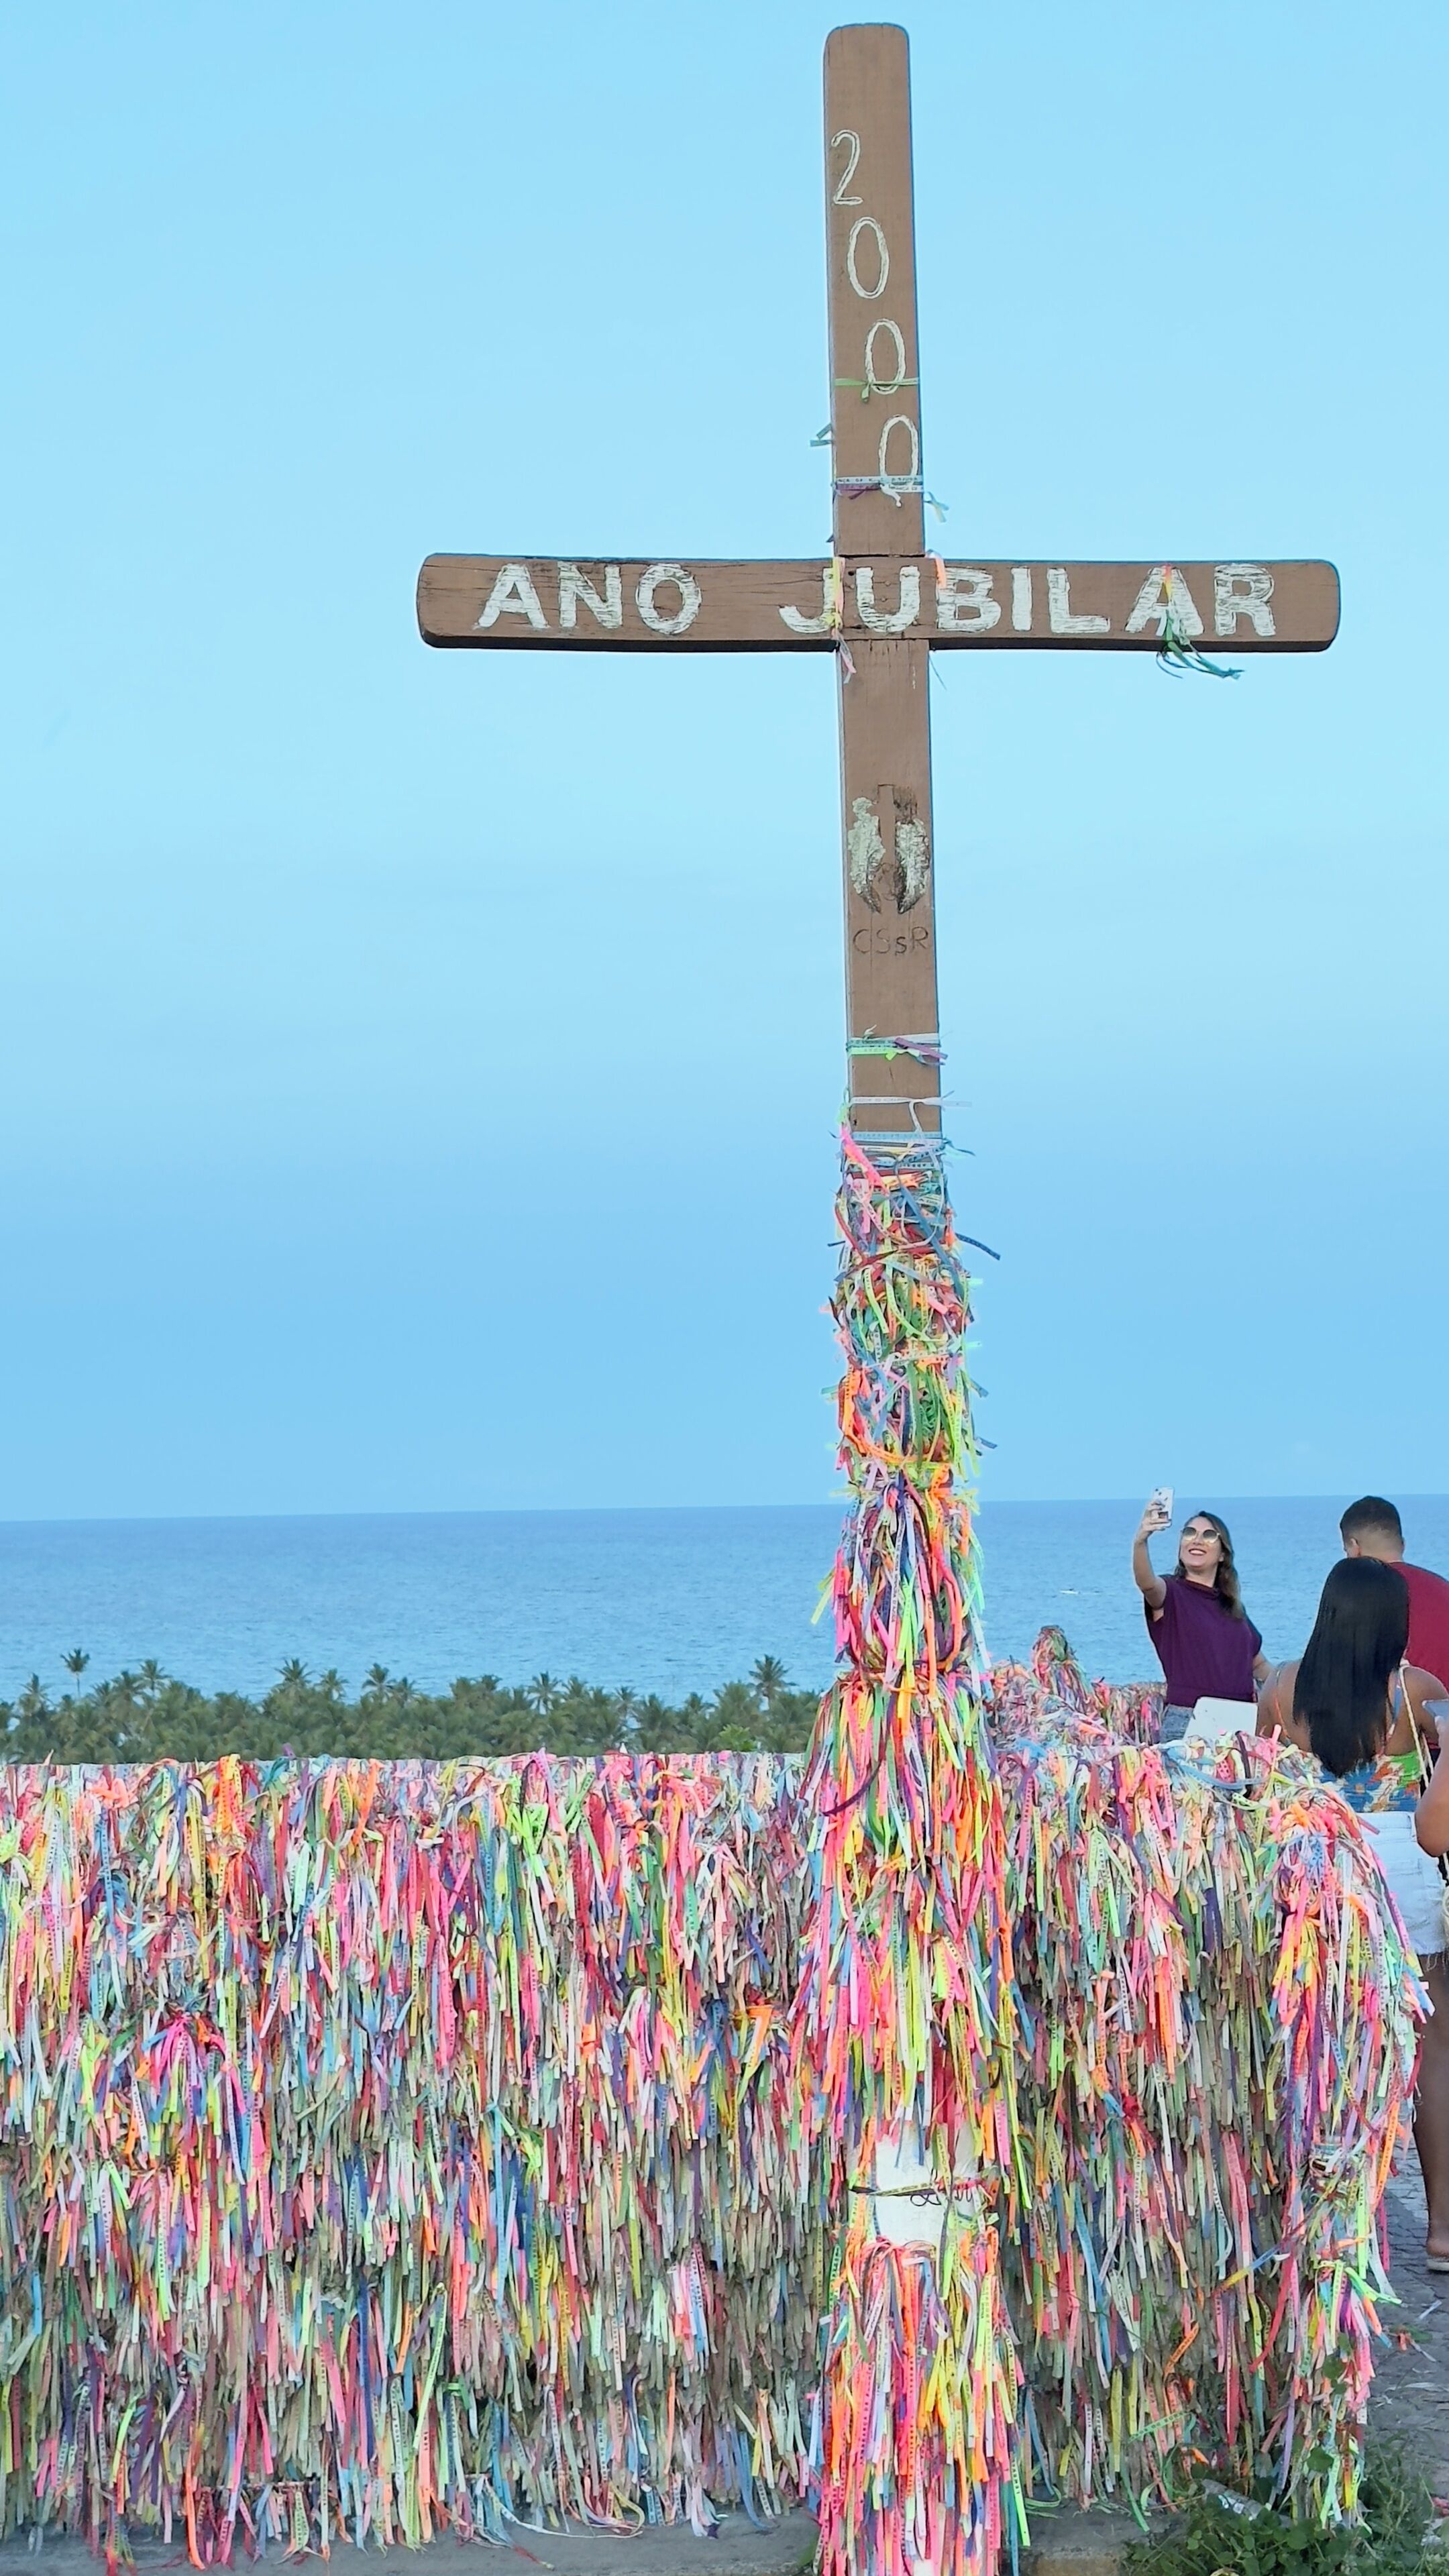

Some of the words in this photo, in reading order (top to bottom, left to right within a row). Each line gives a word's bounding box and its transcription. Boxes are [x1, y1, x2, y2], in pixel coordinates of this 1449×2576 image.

[831, 129, 918, 487] 2000
[472, 561, 702, 635] ANO
[778, 562, 1277, 637] JUBILAR
